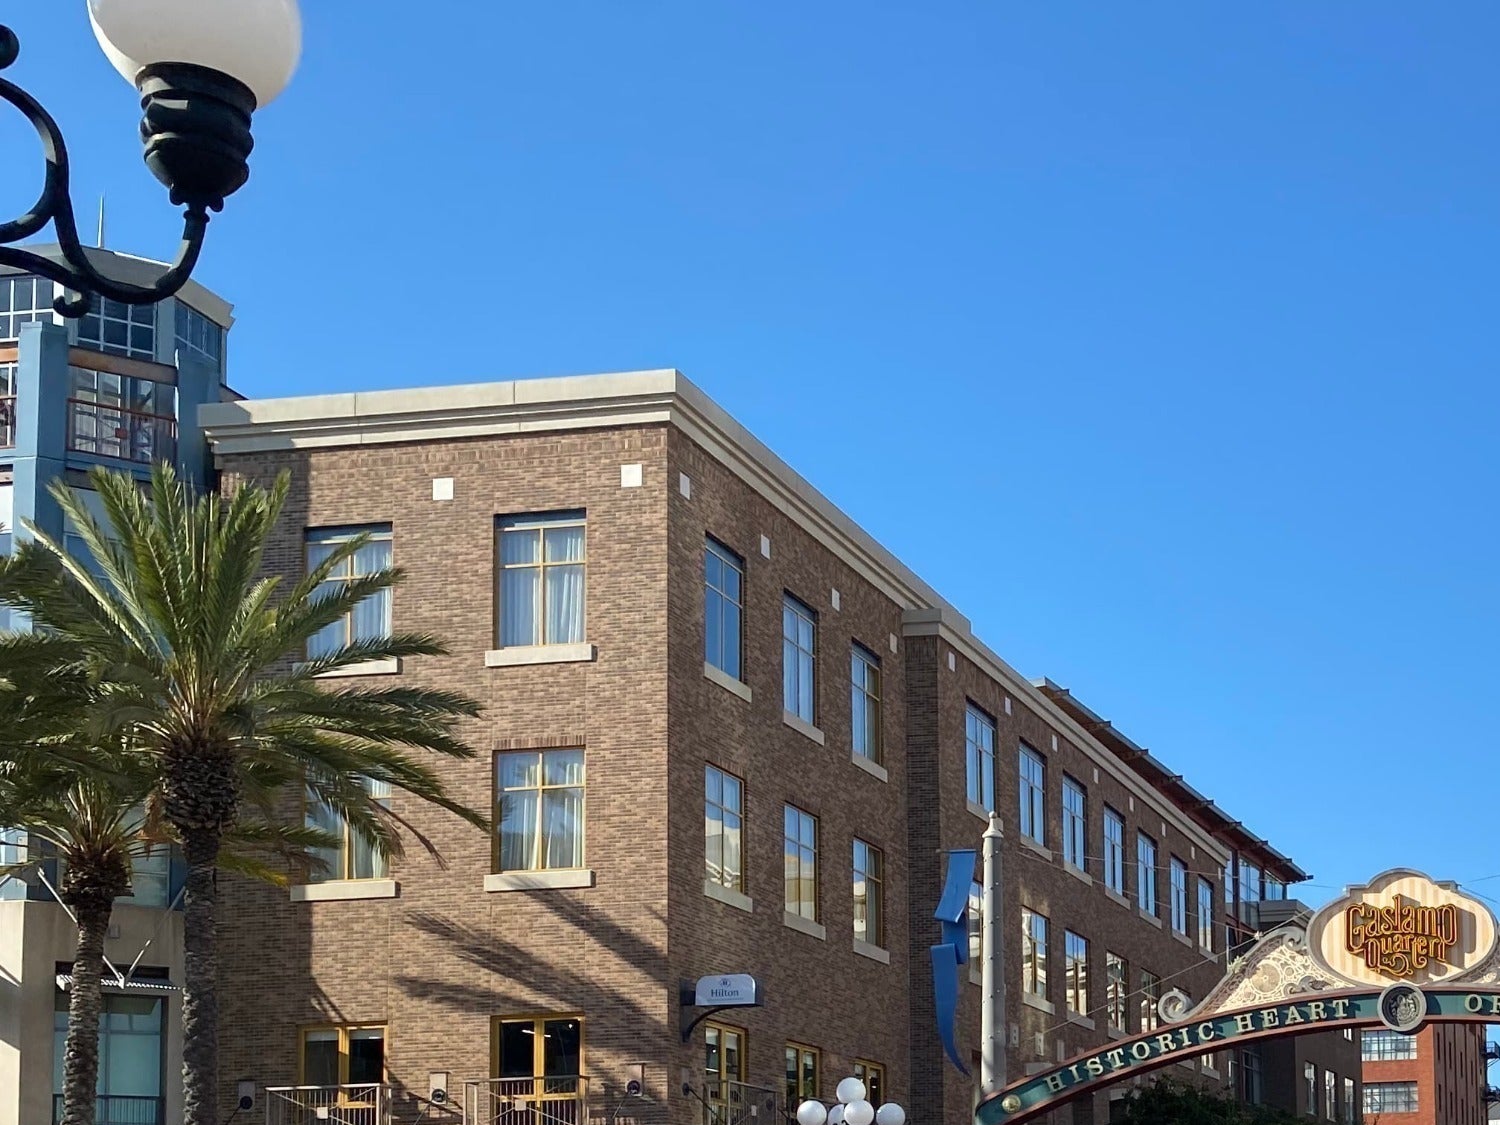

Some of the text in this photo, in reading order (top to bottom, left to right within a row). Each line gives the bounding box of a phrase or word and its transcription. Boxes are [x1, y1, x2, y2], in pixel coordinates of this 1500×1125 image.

[1344, 894, 1457, 954] Gaslamp
[1365, 934, 1446, 977] Quarter
[711, 989, 739, 998] Hilton
[1045, 1022, 1215, 1093] HISTORIC
[1234, 999, 1350, 1033] HEART
